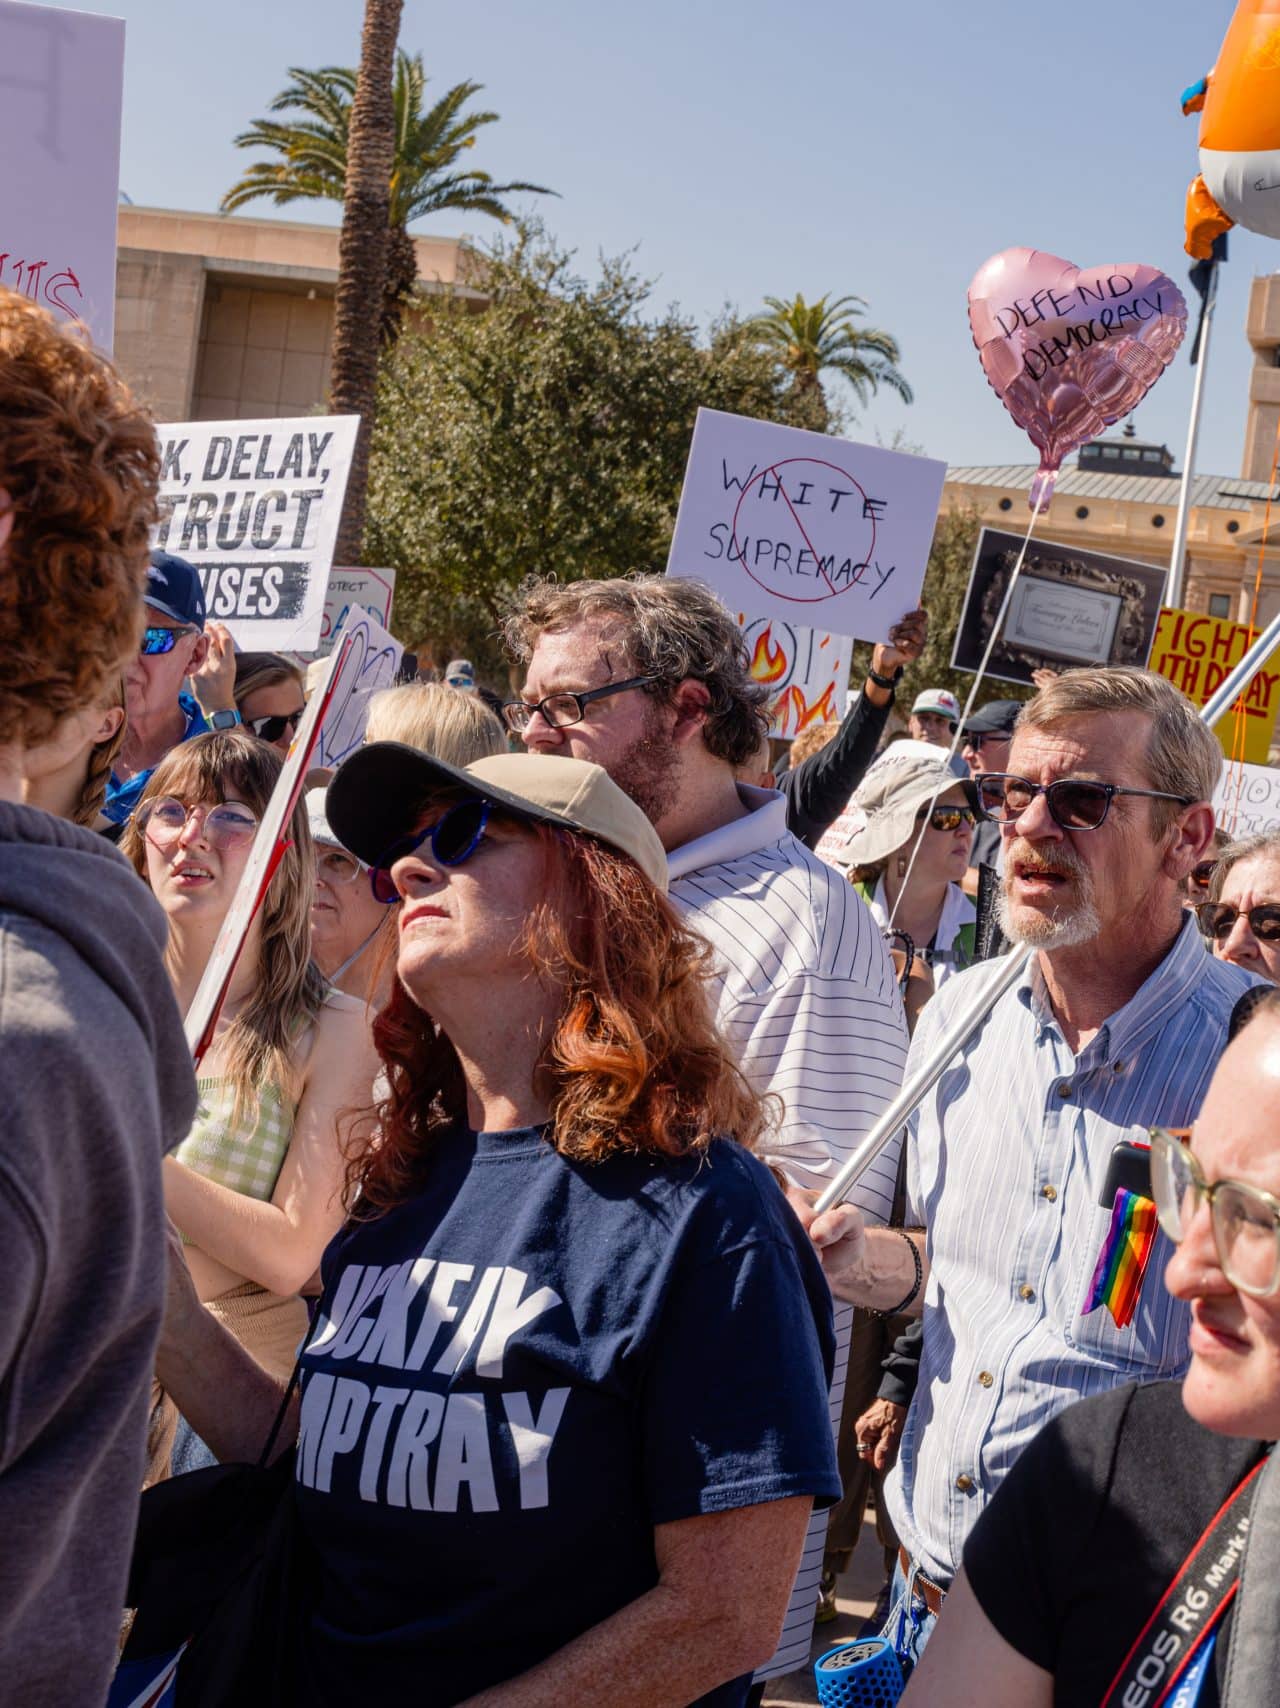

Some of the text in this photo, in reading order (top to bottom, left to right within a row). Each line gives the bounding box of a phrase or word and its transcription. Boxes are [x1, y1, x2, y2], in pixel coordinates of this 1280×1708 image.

[995, 275, 1133, 339] DEFEND
[1022, 294, 1163, 381] DEMOCRACY
[202, 432, 334, 484] DELAY,
[723, 458, 888, 521] WHITE
[156, 489, 324, 550] TRUCT
[199, 567, 284, 616] USES
[328, 581, 369, 592] OTECT
[704, 523, 896, 600] SUPREMACY
[1152, 610, 1260, 663] FIGHT
[296, 1368, 571, 1513] MPTRAY
[1122, 1630, 1182, 1708] EOS
[1170, 1586, 1209, 1633] R6
[1204, 1535, 1247, 1589] Mark
